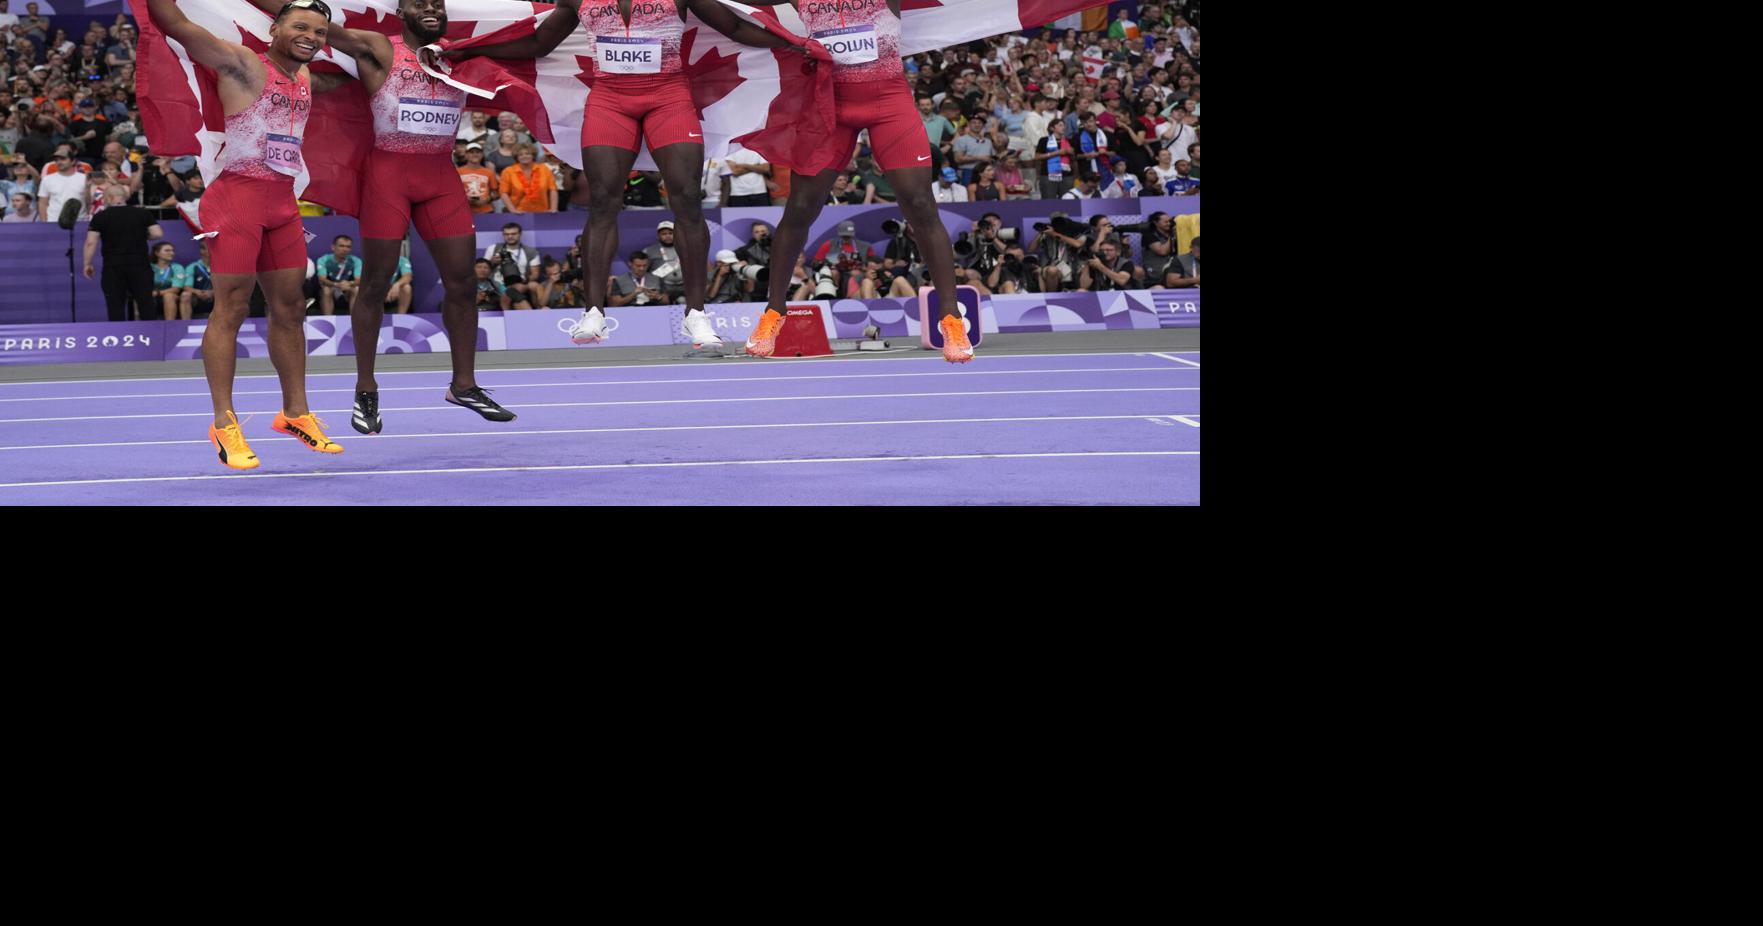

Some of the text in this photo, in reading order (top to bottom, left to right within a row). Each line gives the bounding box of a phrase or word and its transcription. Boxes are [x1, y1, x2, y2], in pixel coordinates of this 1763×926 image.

[590, 3, 665, 18] CANADA
[824, 38, 874, 54] ROWN
[605, 49, 652, 63] BLAKE
[400, 68, 433, 84] CAN
[400, 109, 460, 126] RODNEY
[268, 147, 282, 161] DE
[716, 316, 752, 329] RIS
[4, 334, 151, 351] PARIS 2024
[283, 420, 318, 447] NITRO
